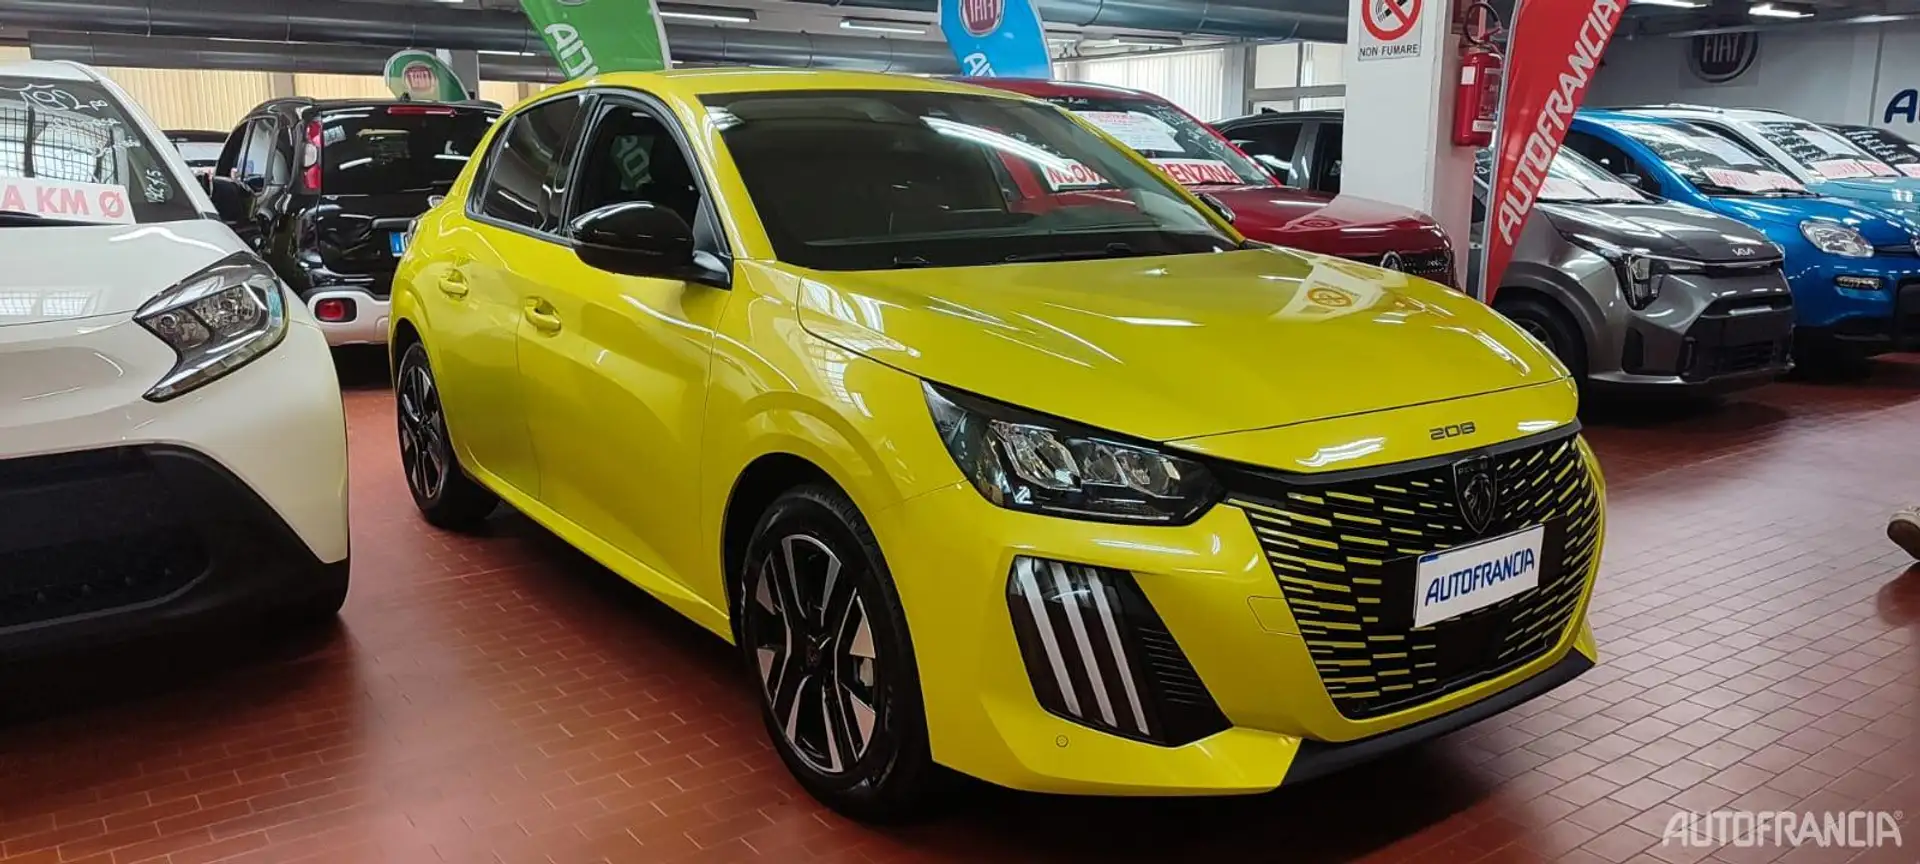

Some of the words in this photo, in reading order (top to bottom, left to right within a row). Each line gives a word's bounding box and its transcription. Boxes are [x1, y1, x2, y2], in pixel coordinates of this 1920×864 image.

[1359, 47, 1379, 57] NON
[1381, 43, 1419, 55] FUMARE
[1703, 33, 1740, 62] FIAT
[1498, 0, 1621, 246] AUTOFRANCIA
[36, 186, 90, 216] KM
[1429, 421, 1476, 440] 208
[1424, 547, 1536, 606] AUTOFRANCIA
